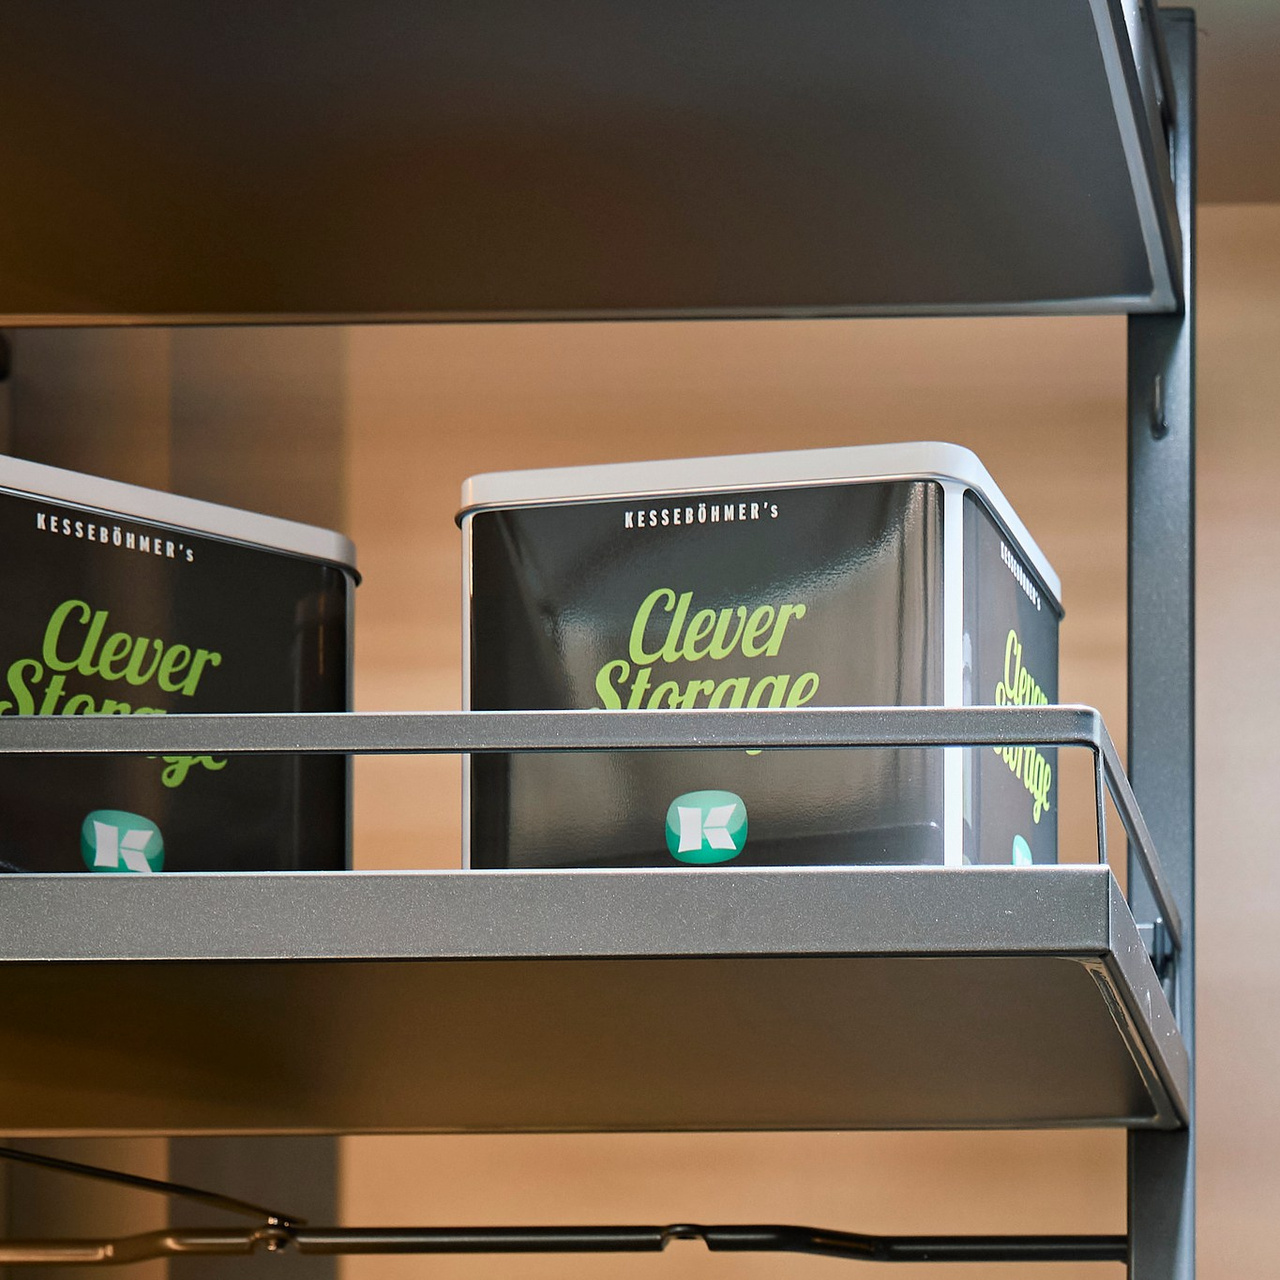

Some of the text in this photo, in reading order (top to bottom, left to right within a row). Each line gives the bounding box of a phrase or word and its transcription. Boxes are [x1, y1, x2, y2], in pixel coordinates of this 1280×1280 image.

[37, 513, 195, 562] KESSEBÖHMER's
[624, 501, 779, 529] KESSEBÖHMER's
[42, 600, 221, 696] Clever
[629, 588, 806, 664] Clever
